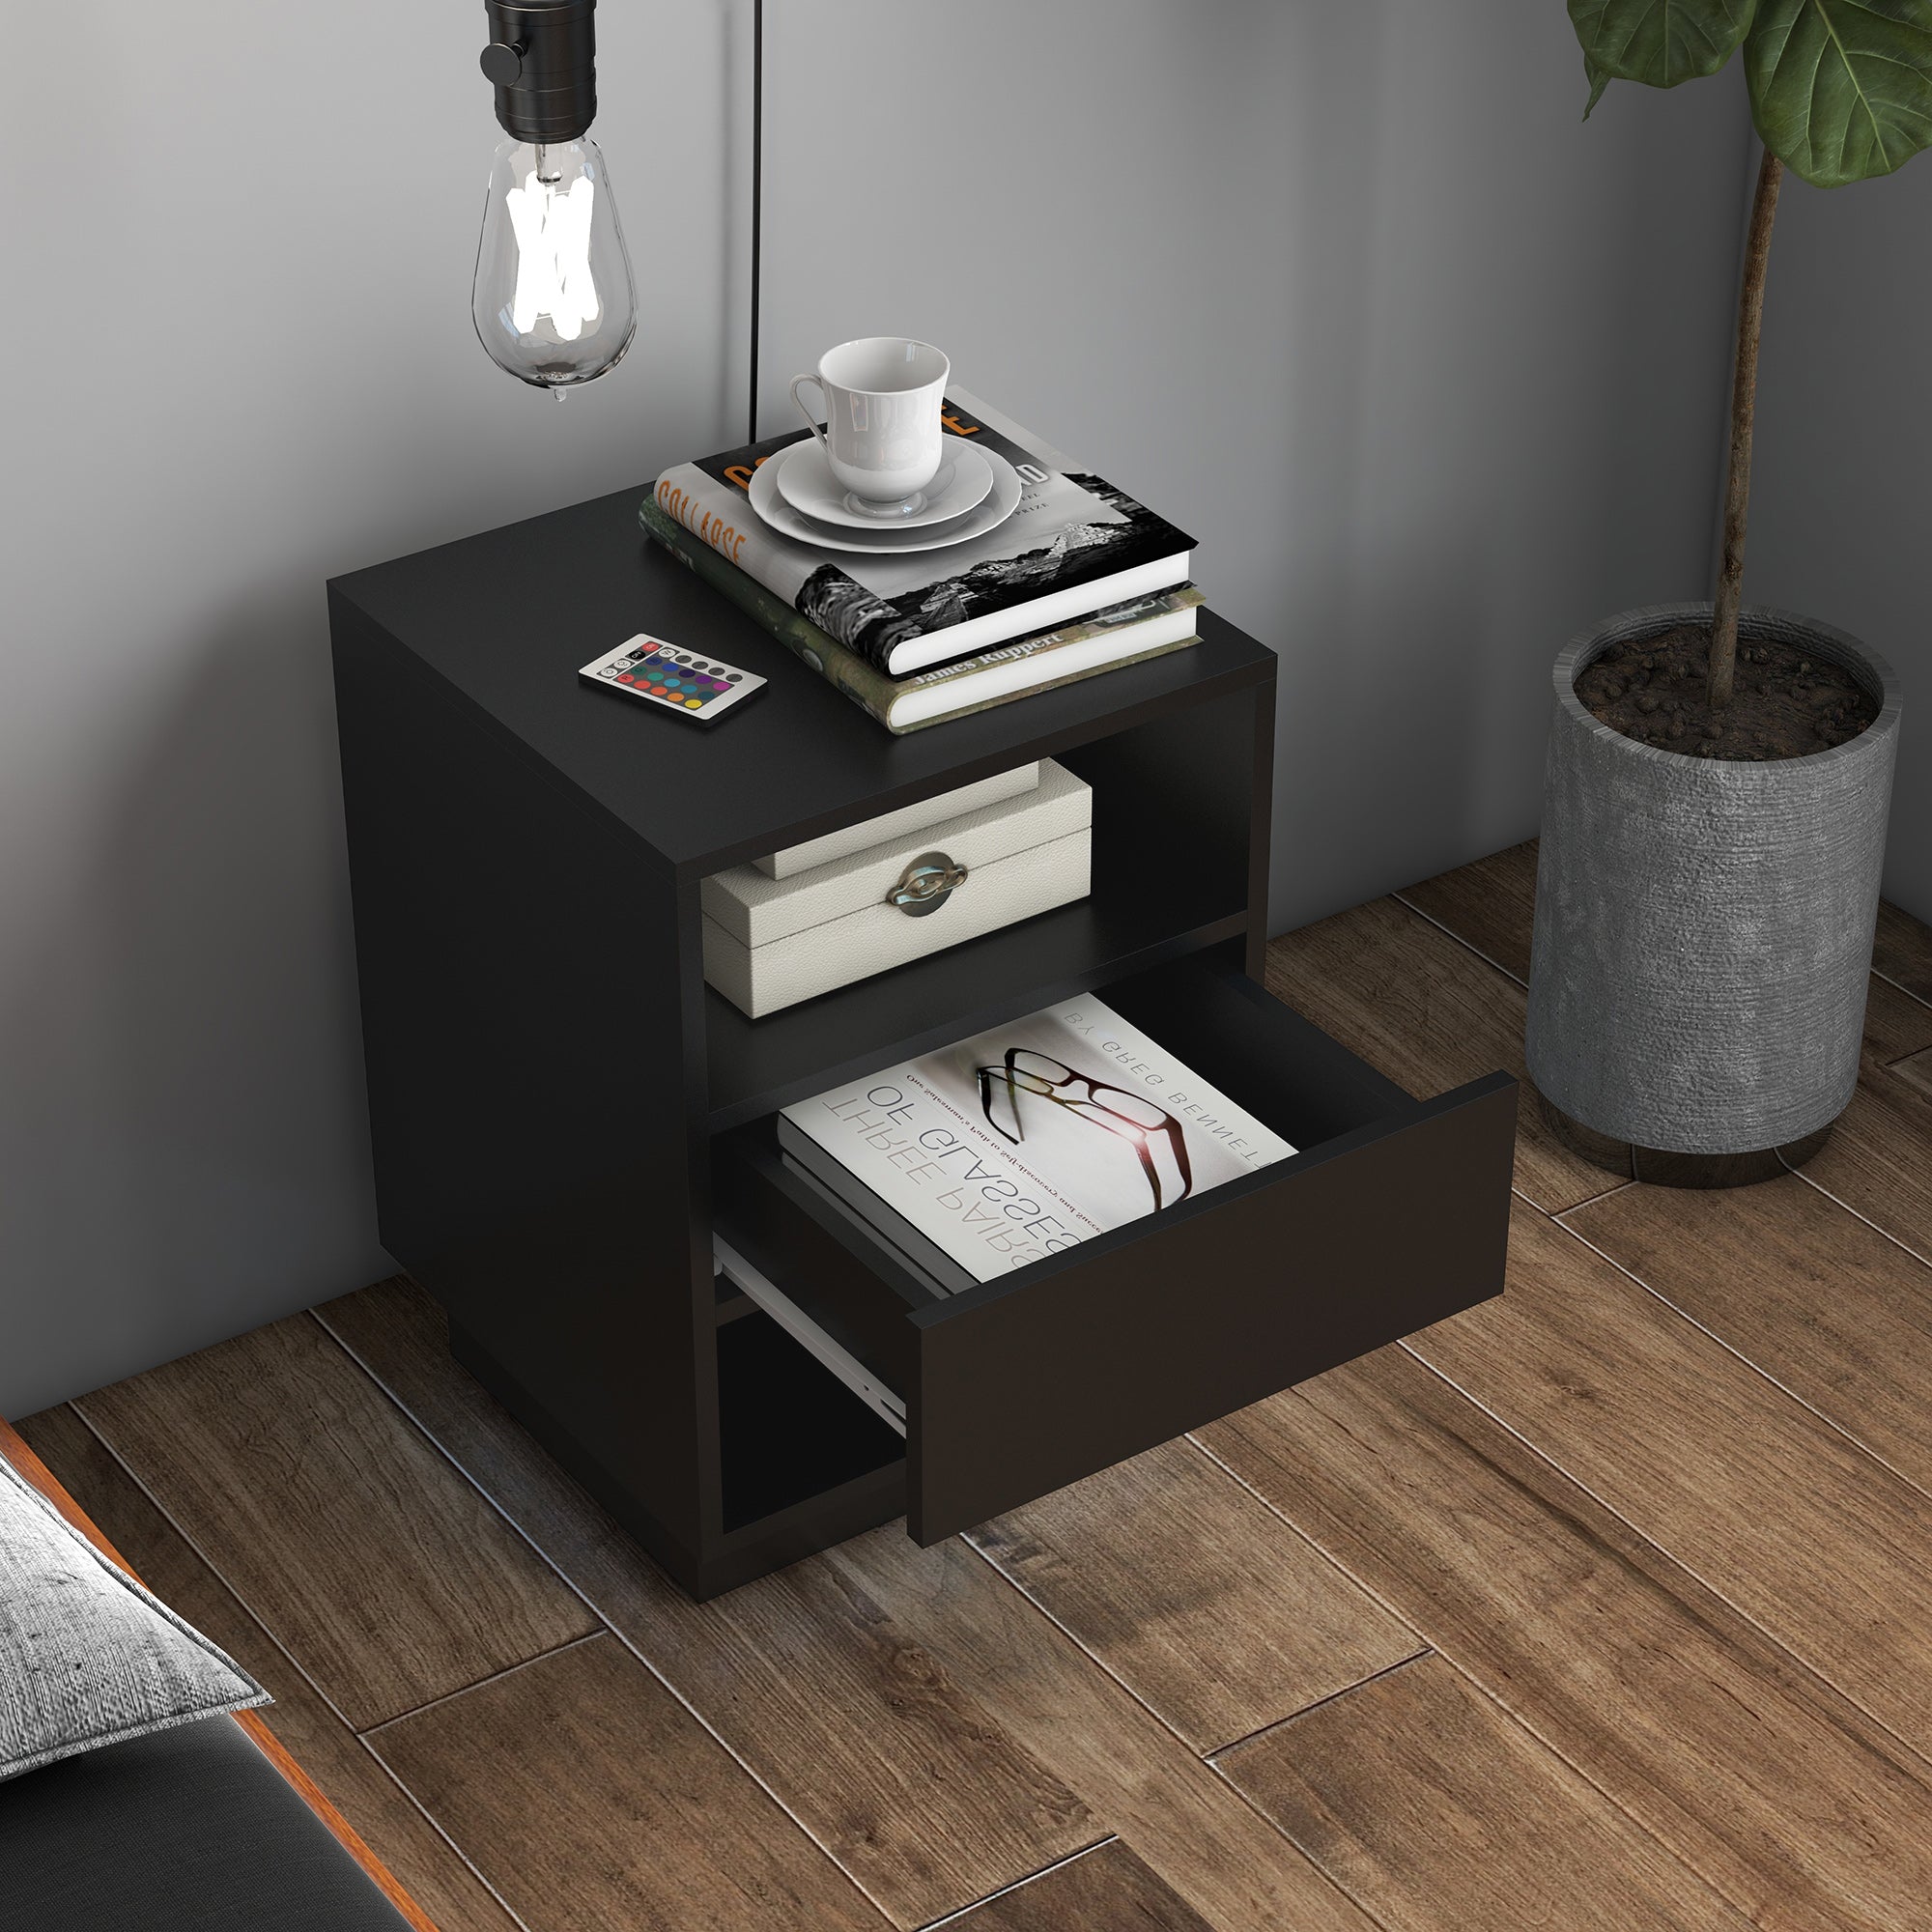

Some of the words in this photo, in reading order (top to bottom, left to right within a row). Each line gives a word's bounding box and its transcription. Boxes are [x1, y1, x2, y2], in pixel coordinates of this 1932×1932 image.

[657, 480, 747, 566] COLLAPSE
[914, 660, 978, 686] James
[978, 633, 1065, 665] Ruppert
